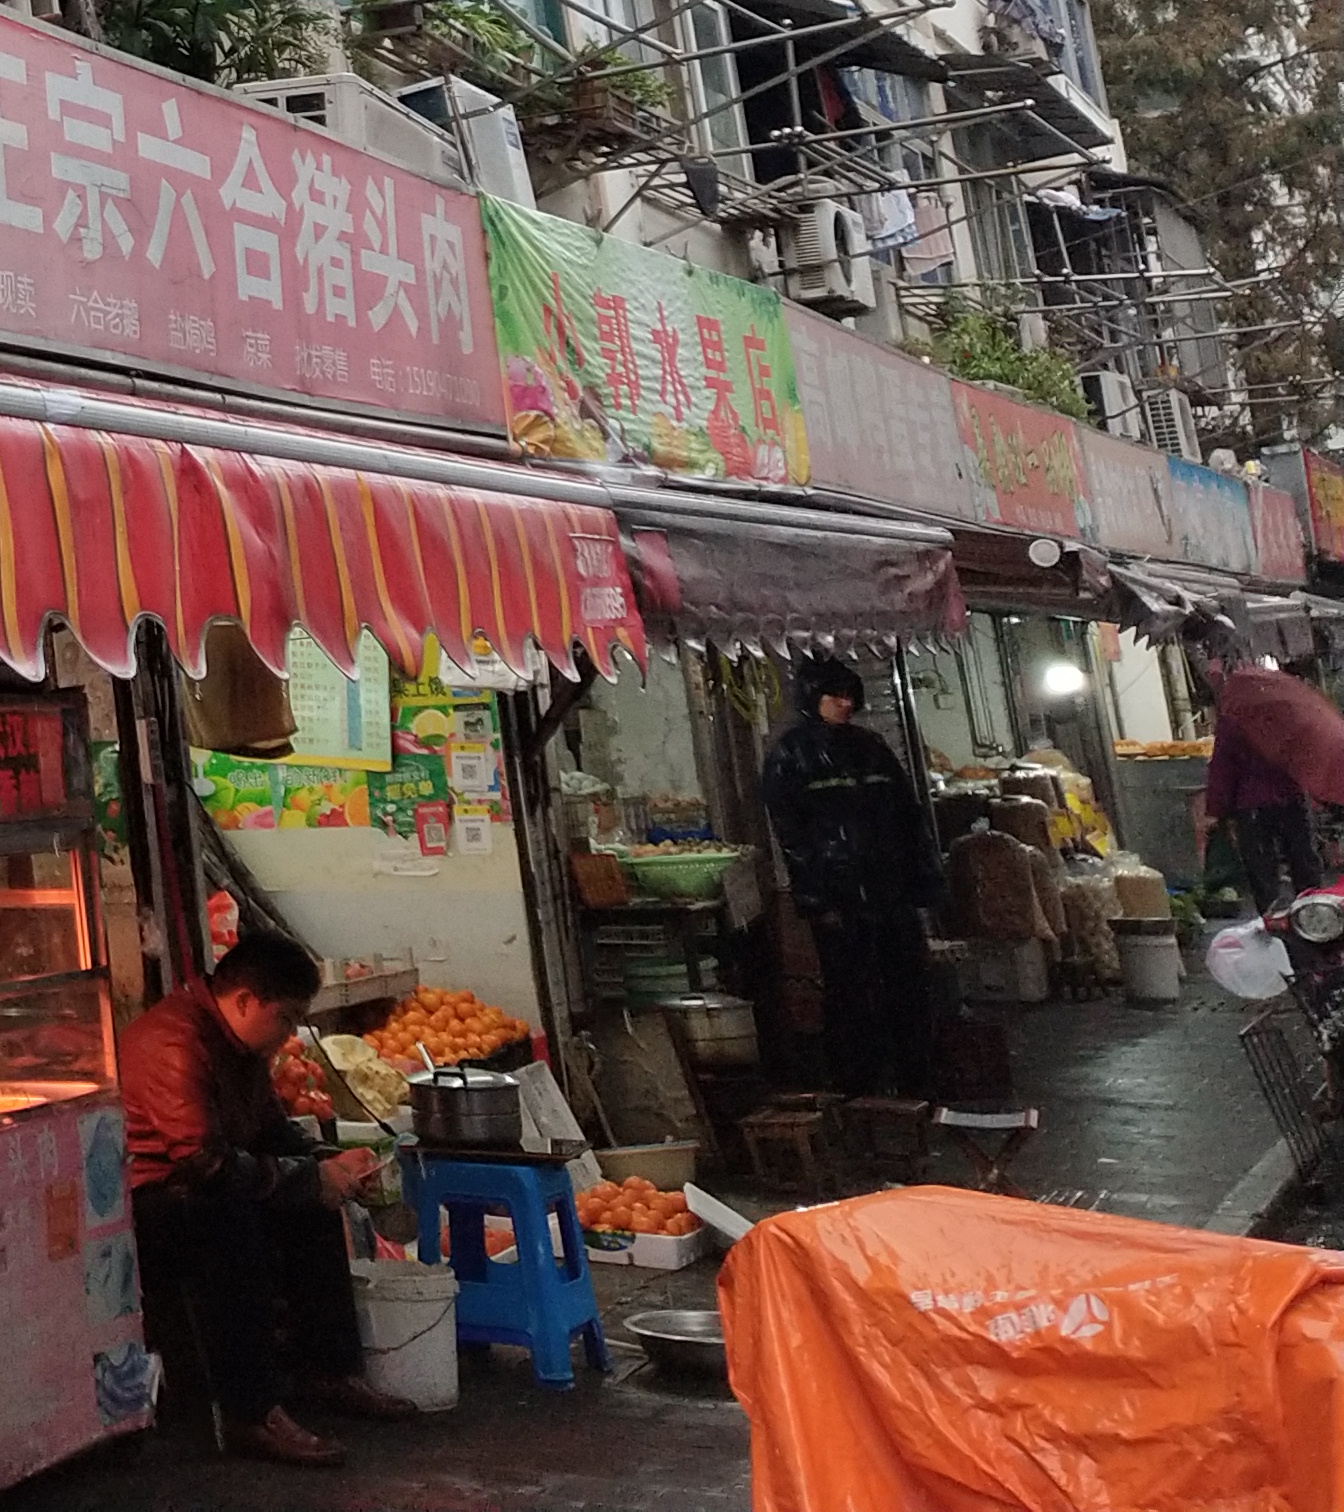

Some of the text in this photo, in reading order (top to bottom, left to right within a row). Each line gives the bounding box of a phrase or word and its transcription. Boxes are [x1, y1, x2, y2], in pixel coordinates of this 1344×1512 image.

[542, 271, 782, 438] 小郭水果店
